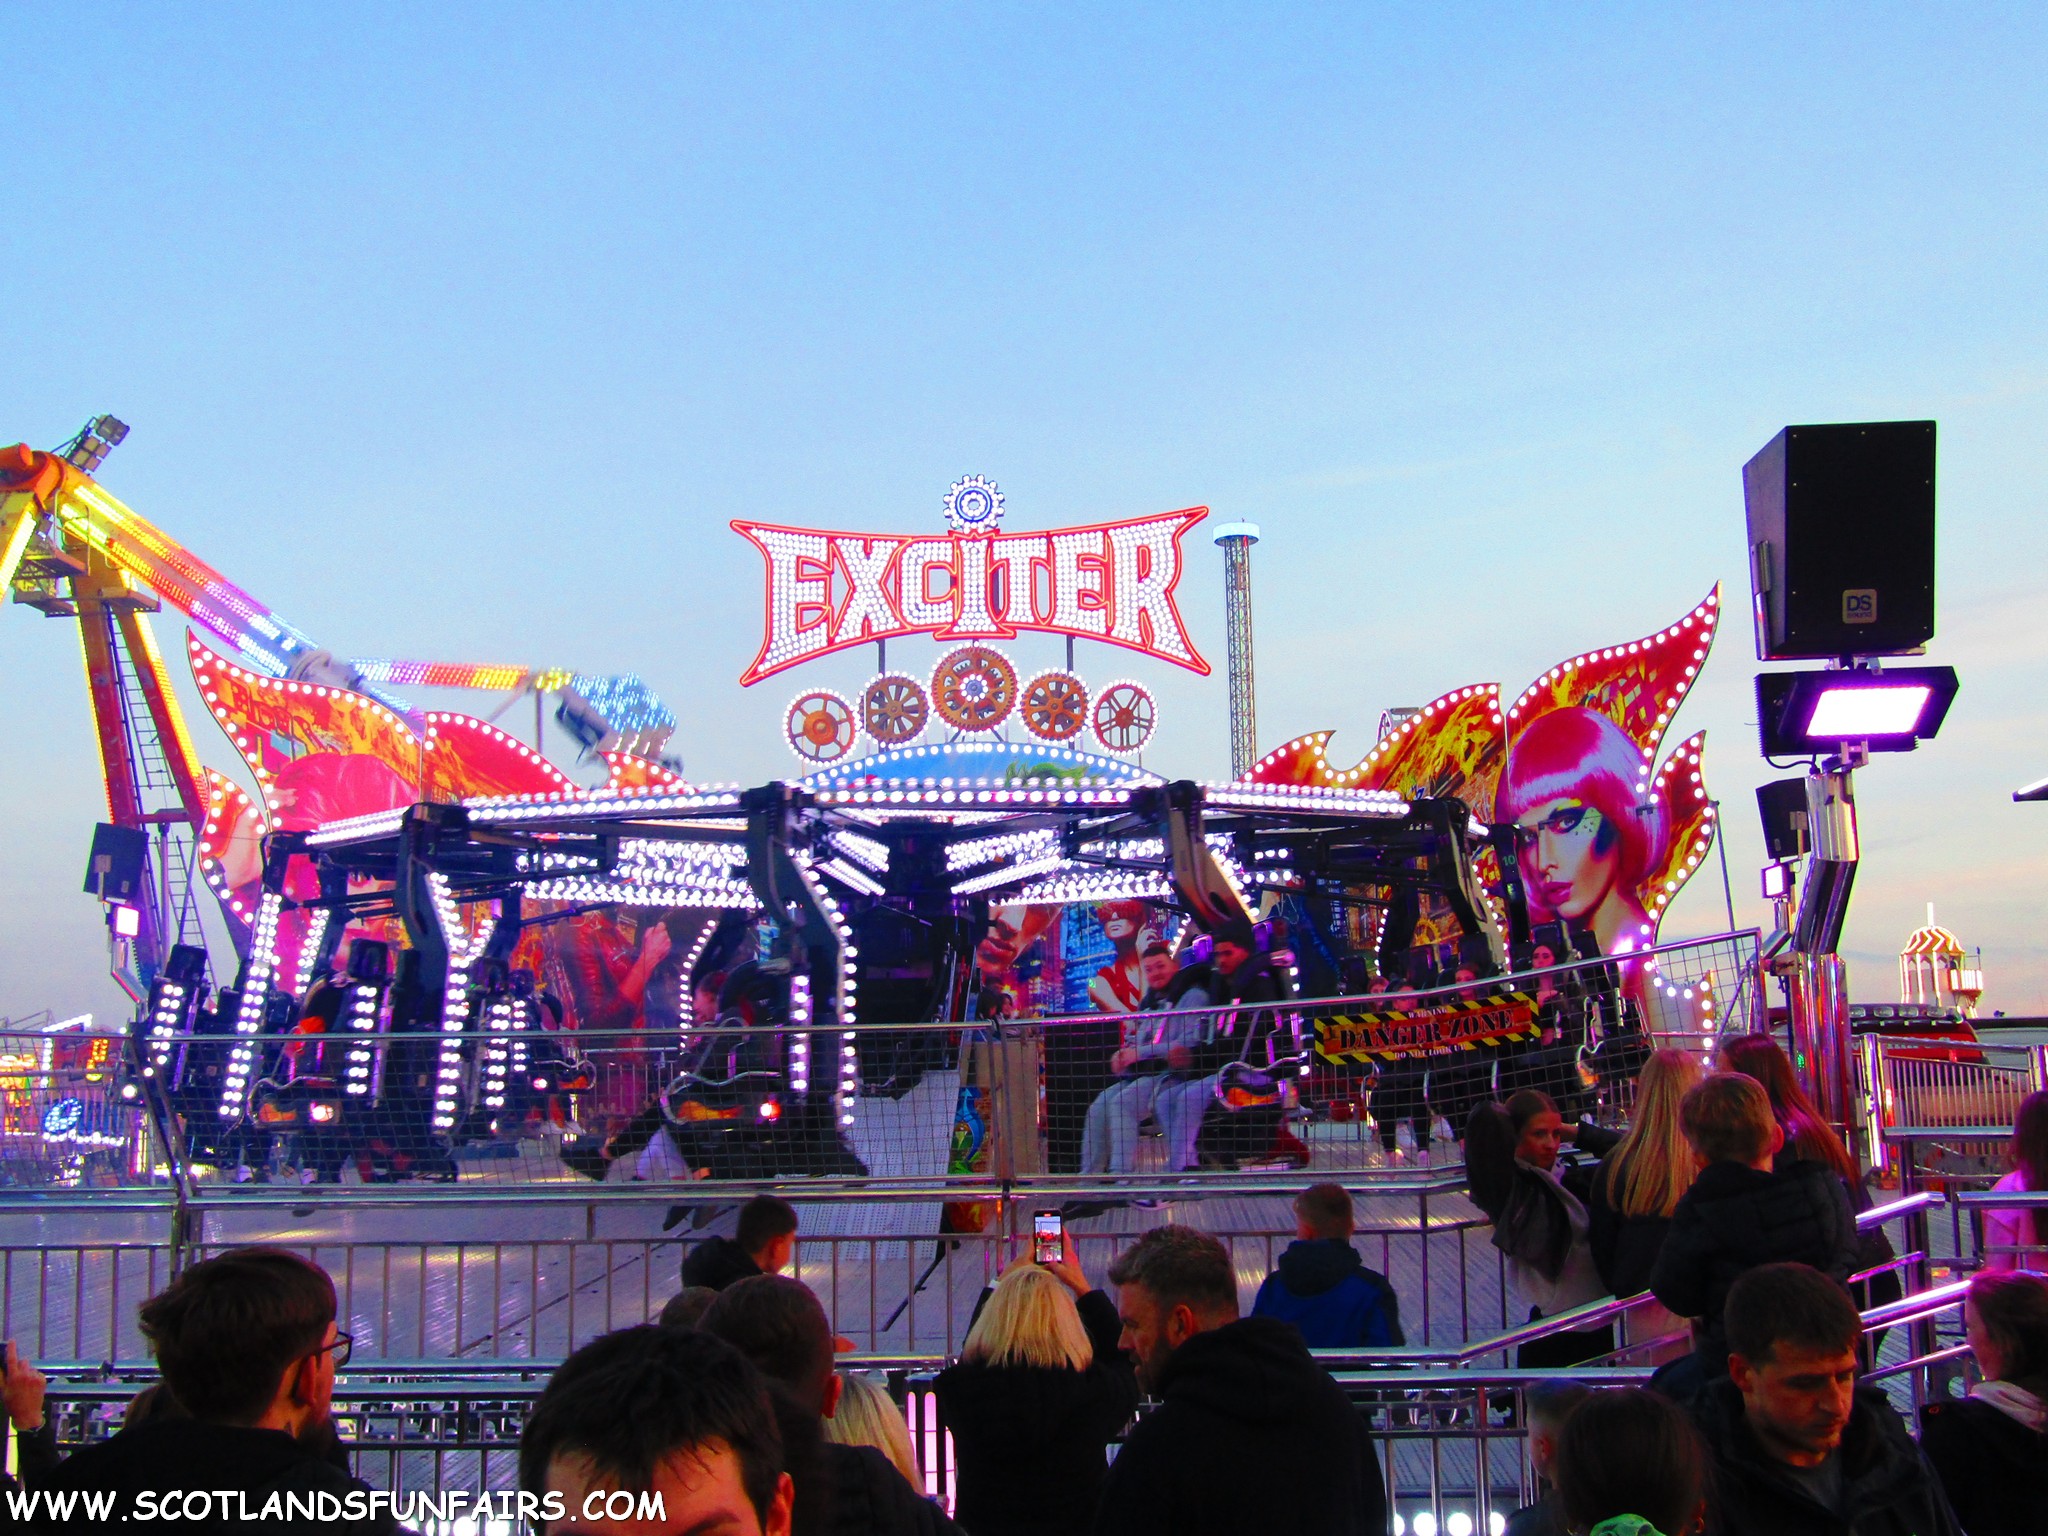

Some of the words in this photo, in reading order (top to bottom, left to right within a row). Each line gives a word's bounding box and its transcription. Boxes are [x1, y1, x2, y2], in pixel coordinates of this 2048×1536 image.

[730, 505, 1212, 688] EXCITER
[1847, 595, 1872, 611] DS
[1502, 855, 1516, 866] 10
[1408, 1007, 1448, 1019] WARNING
[1340, 1022, 1442, 1049] DANGER
[1449, 1008, 1514, 1039] ZONE
[1394, 1051, 1407, 1060] DO
[1408, 1050, 1428, 1058] NOT
[1429, 1046, 1453, 1057] LOOK
